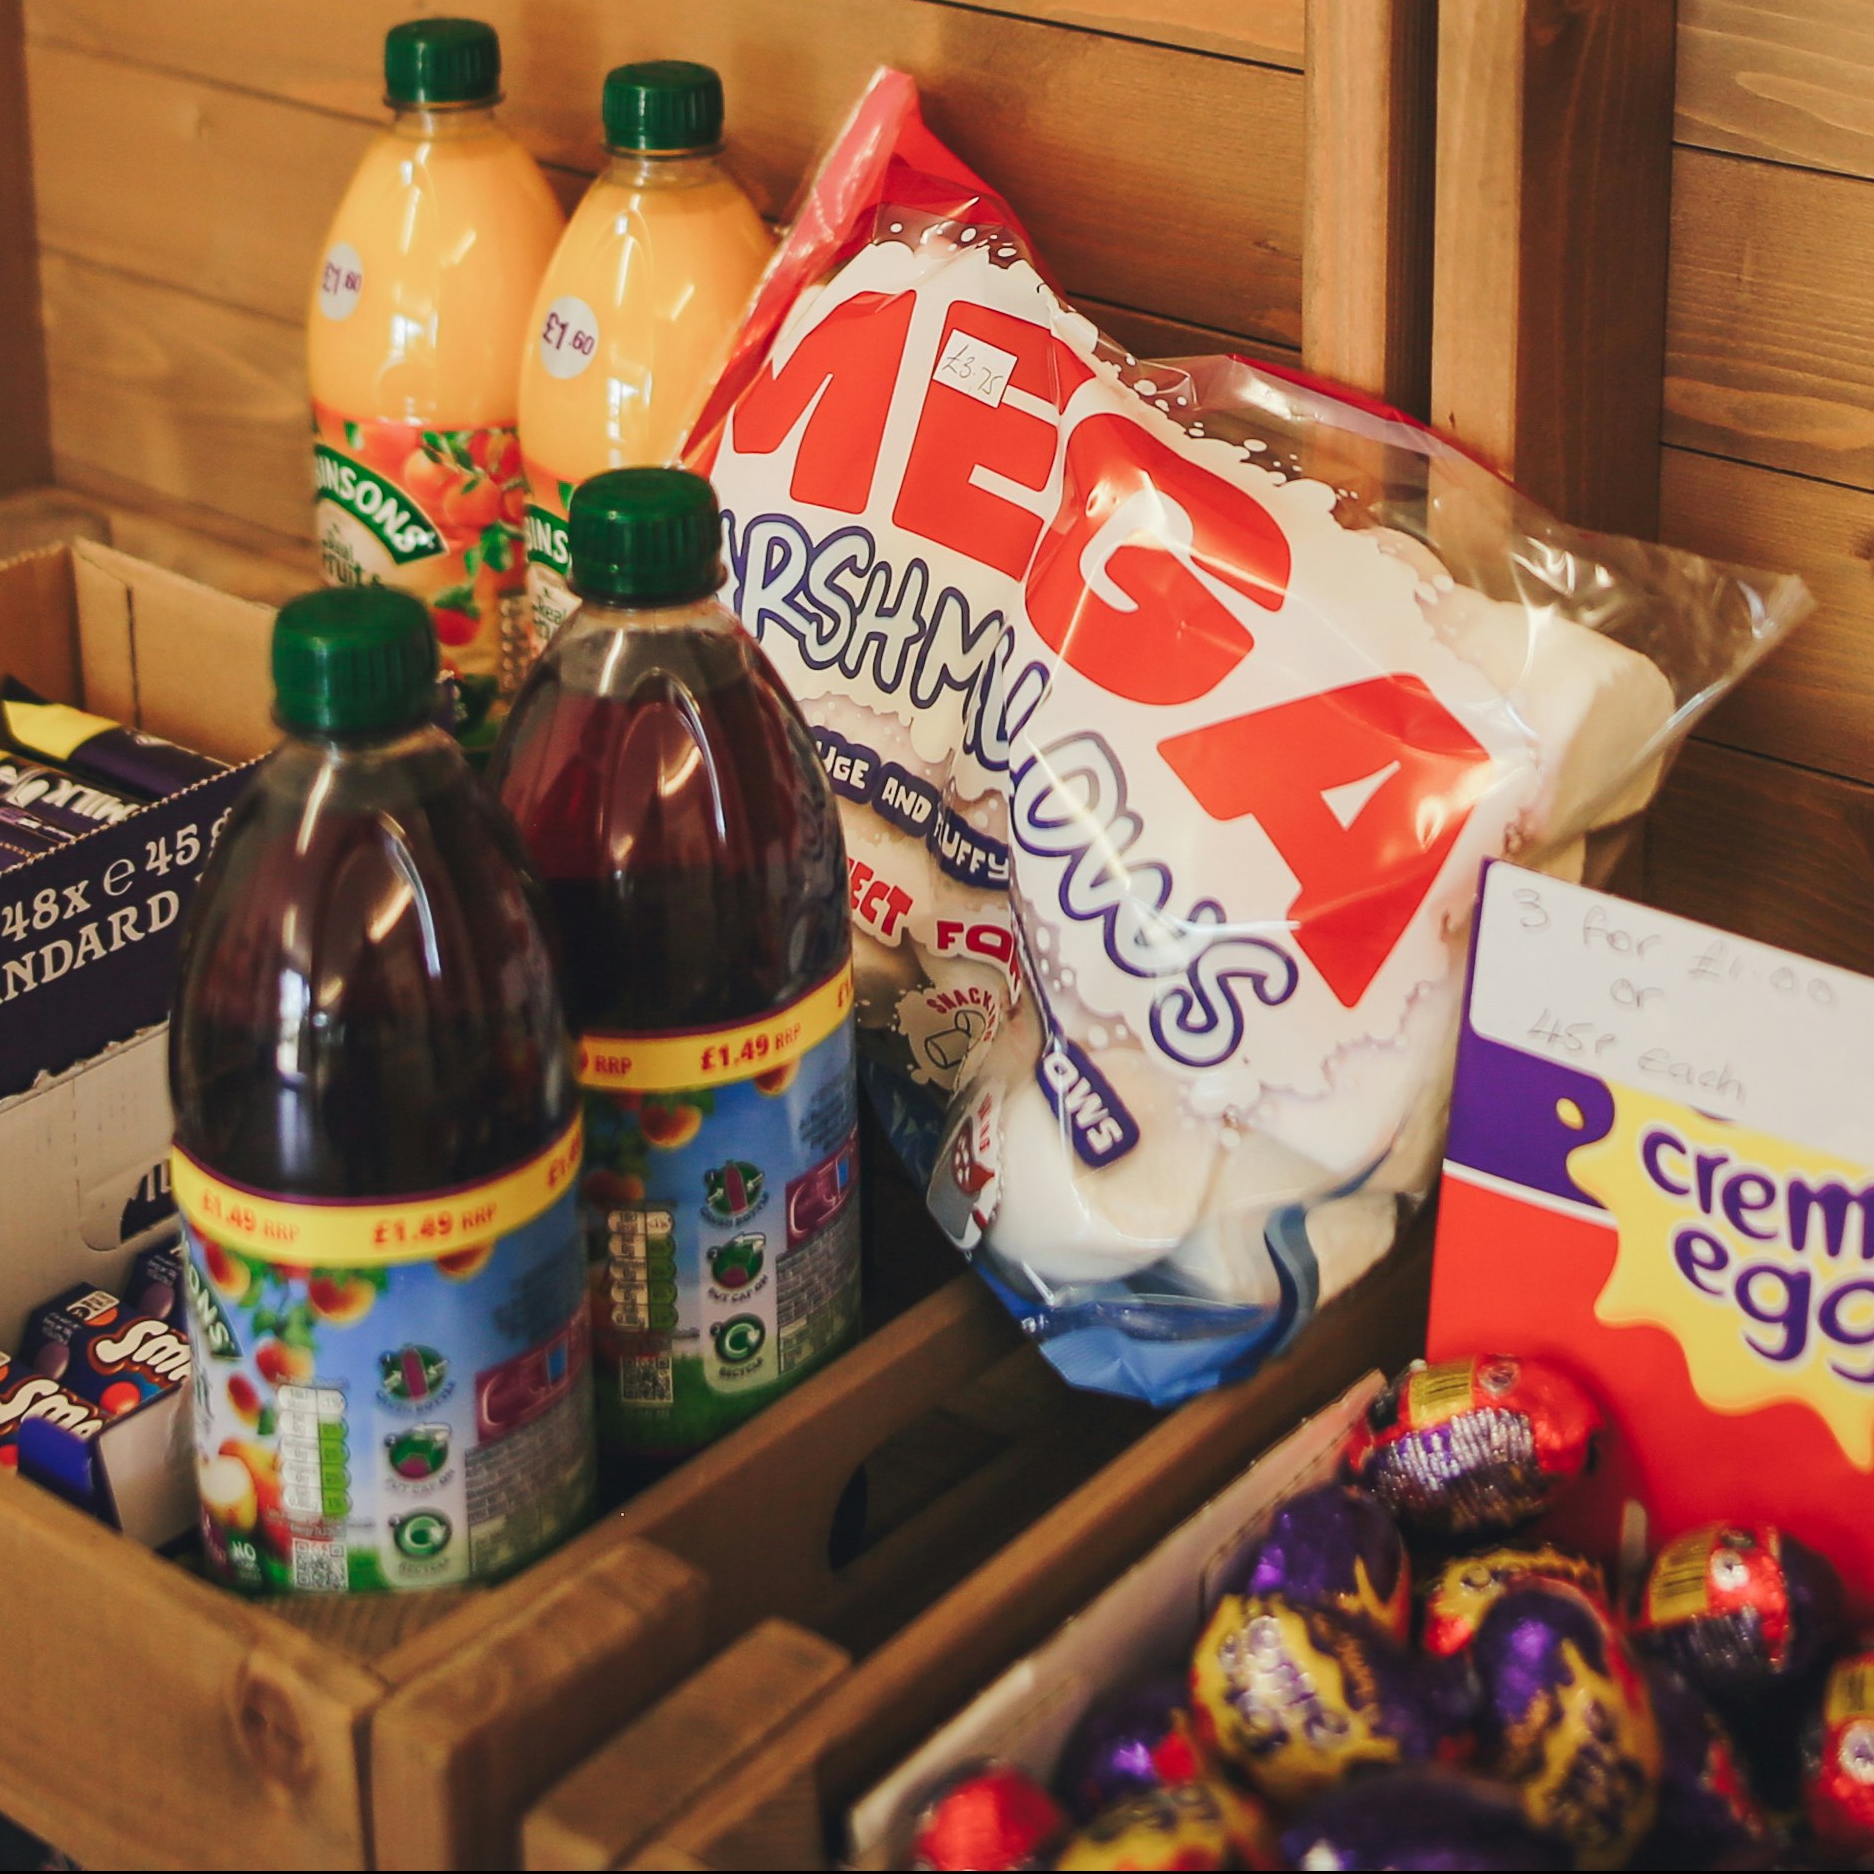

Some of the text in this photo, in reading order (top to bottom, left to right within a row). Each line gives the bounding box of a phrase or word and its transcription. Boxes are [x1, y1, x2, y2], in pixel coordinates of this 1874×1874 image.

[542, 311, 595, 357] £1.60
[942, 344, 1003, 395] £3.75
[731, 288, 1492, 1009] MEGA
[816, 740, 870, 790] UGE
[881, 777, 933, 824] AND
[1, 823, 201, 941] 48x 45
[1514, 888, 1835, 1006] 3 for £1.00
[1610, 978, 1666, 1007] or
[594, 1055, 632, 1076] RRP
[701, 1023, 801, 1071] £1.49 RRP
[203, 1188, 256, 1232] £1.49
[373, 1202, 497, 1245] £1.49 RRP
